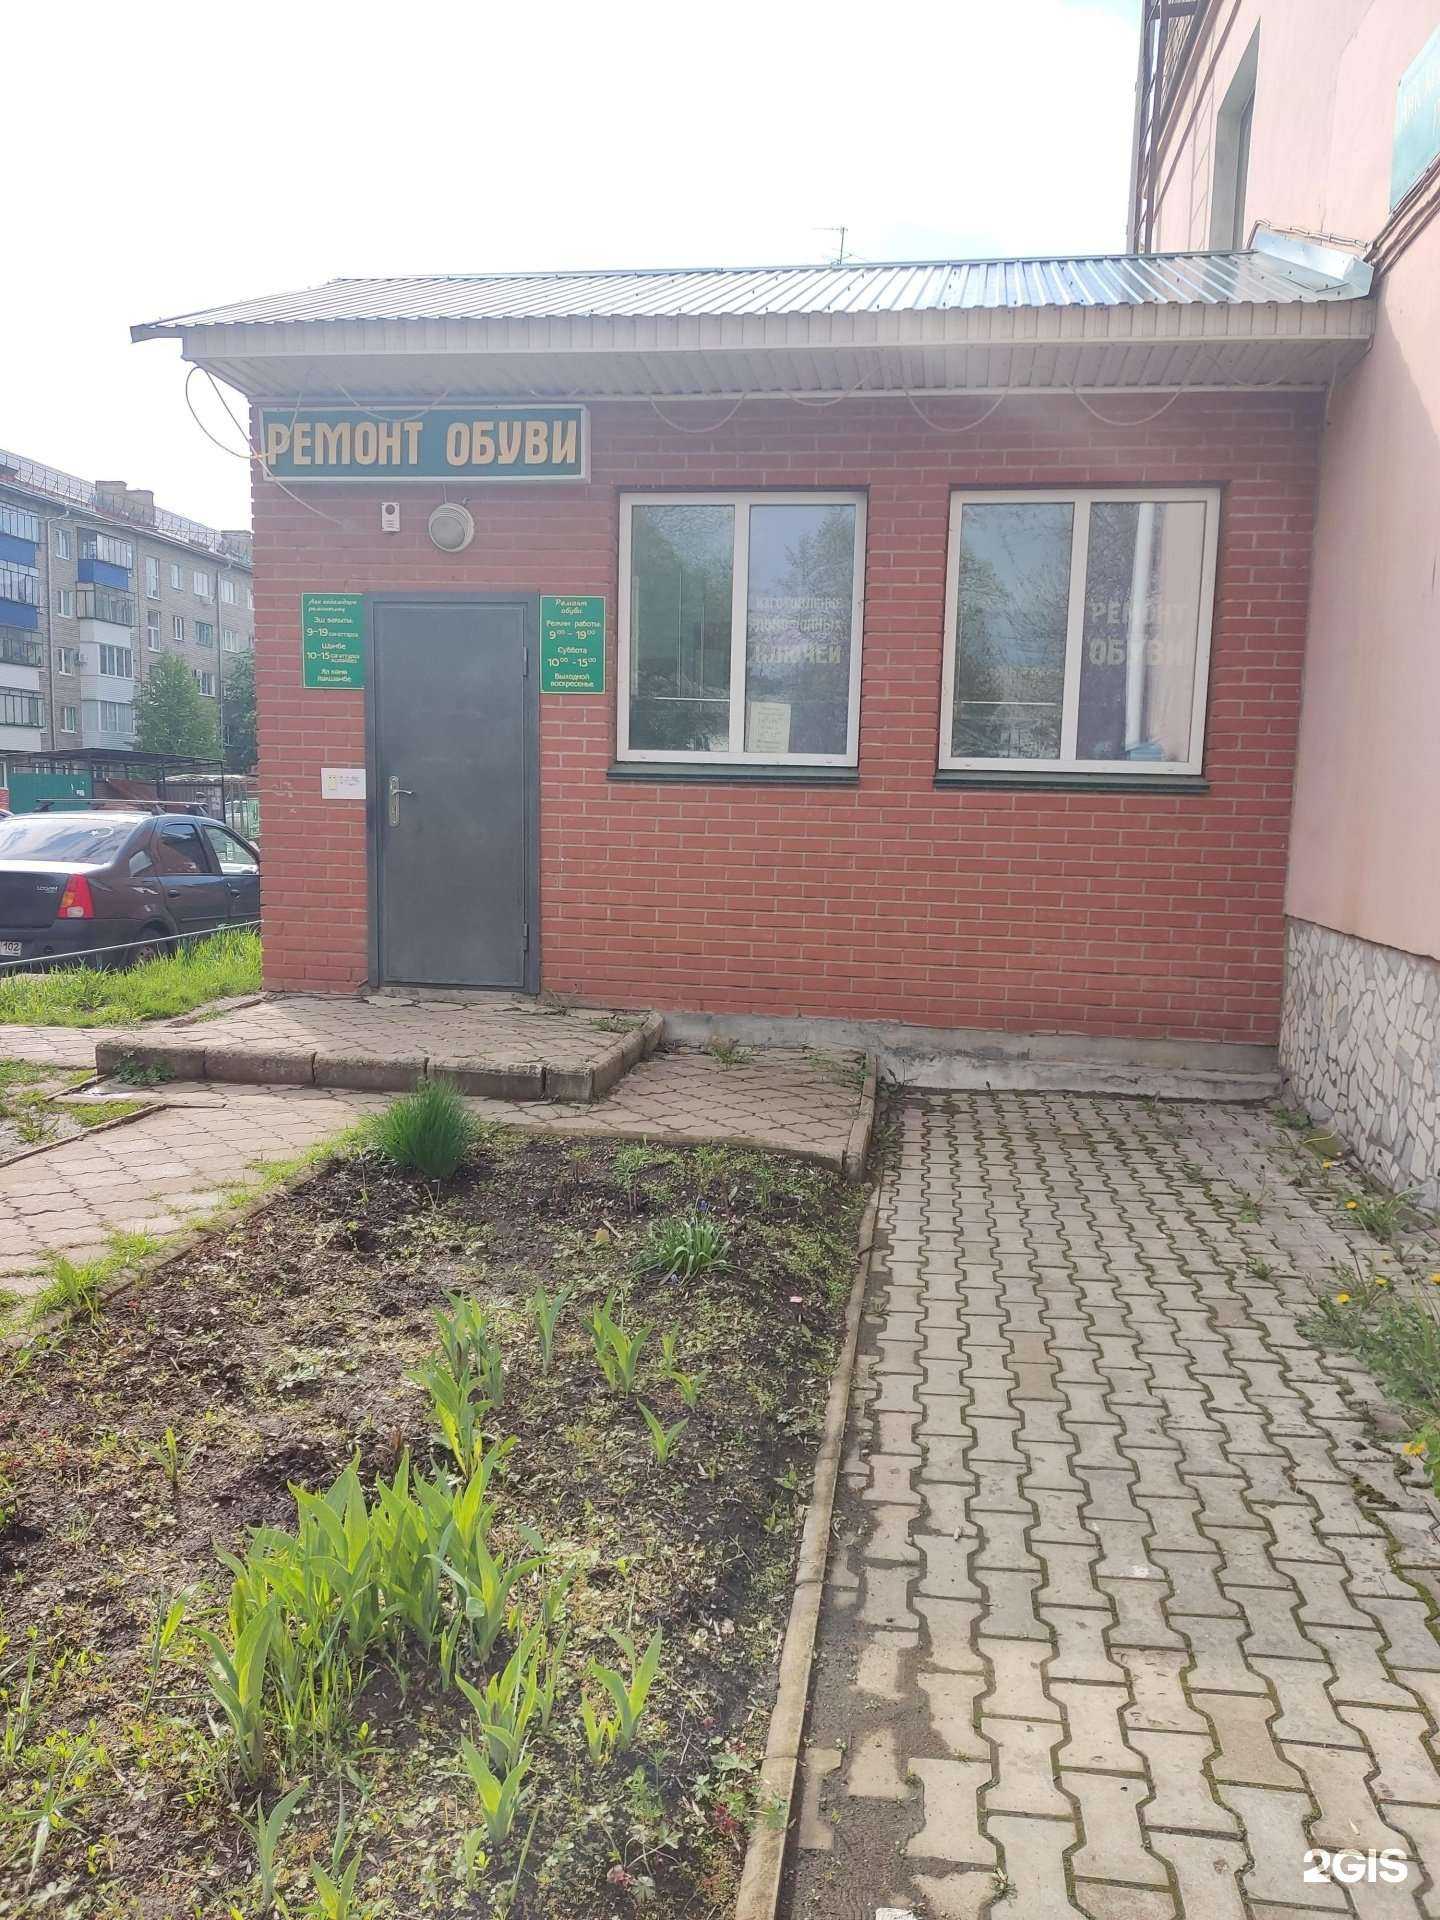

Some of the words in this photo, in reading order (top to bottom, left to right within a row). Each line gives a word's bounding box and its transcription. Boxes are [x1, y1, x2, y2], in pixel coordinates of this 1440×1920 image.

[267, 421, 423, 466] РЕМОНТ
[446, 420, 577, 466] ОБУВИ
[574, 619, 601, 628] работы
[557, 646, 588, 655] Суббота
[554, 672, 590, 681] Выходной
